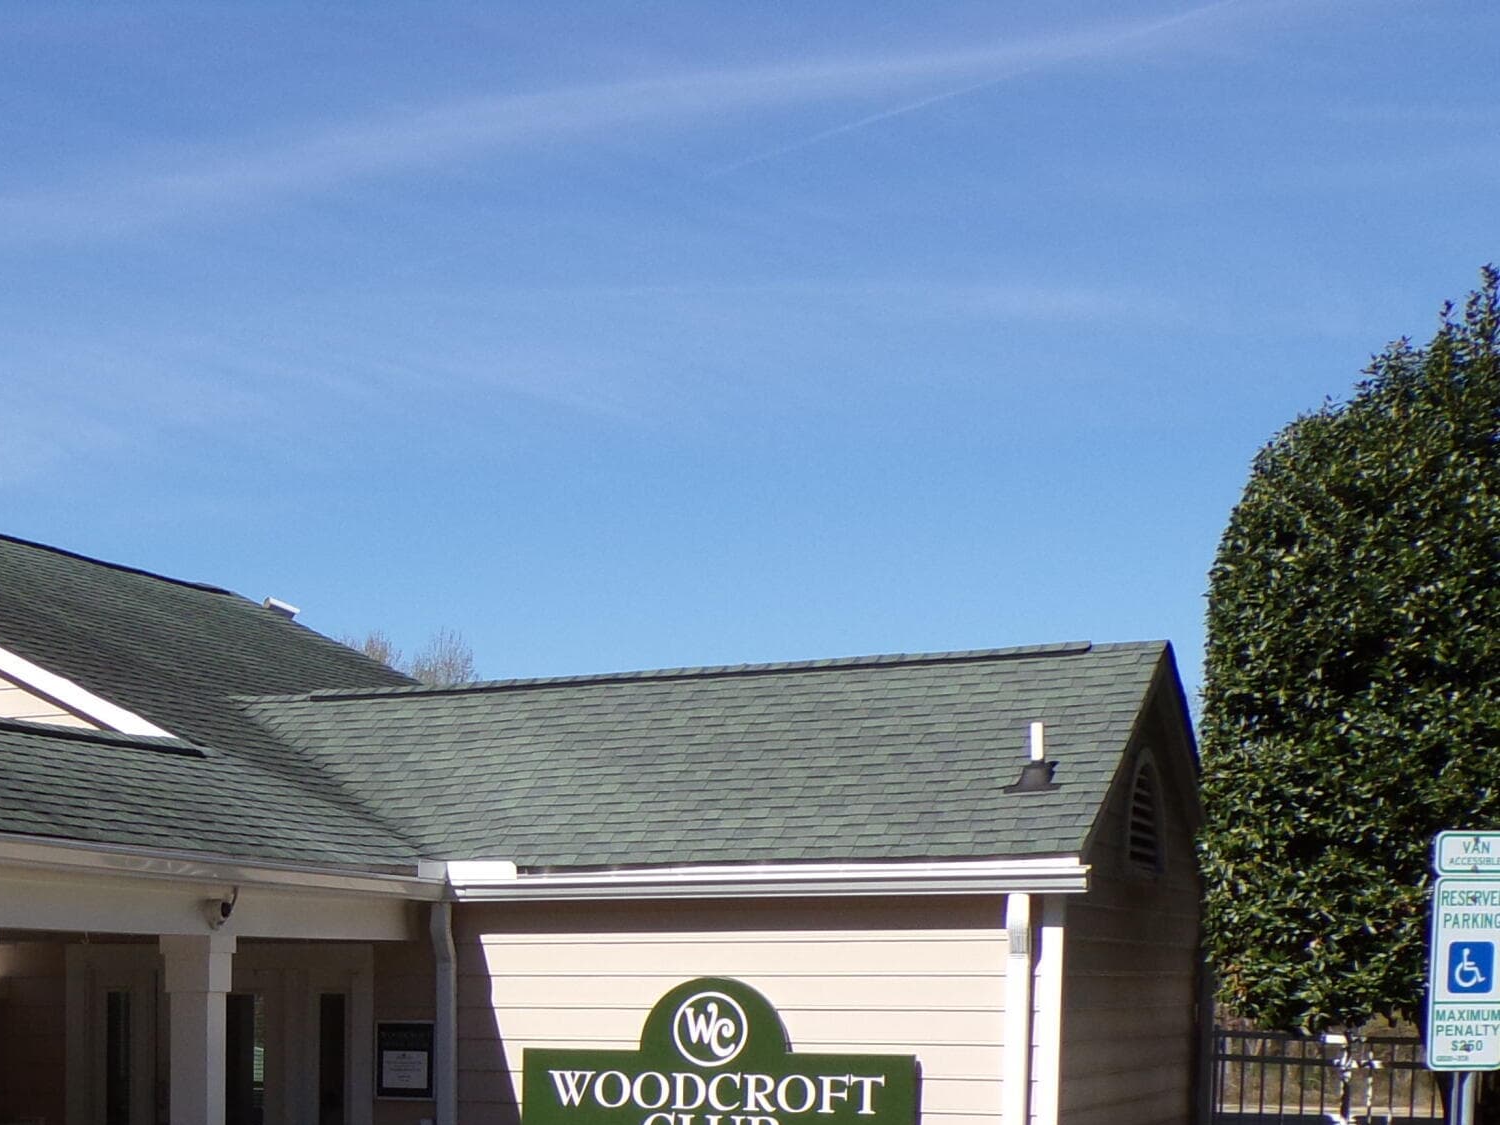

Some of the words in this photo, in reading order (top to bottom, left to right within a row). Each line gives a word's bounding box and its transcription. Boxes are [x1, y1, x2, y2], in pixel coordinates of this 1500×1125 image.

[1462, 841, 1490, 854] VAN
[1441, 890, 1500, 906] RESERVE
[1443, 913, 1500, 929] PARKING
[1435, 1009, 1500, 1021] MAXIMUM
[684, 1002, 736, 1058] WC
[1436, 1024, 1500, 1036] PENALTY
[1451, 1039, 1483, 1052] $250
[548, 1069, 885, 1115] WOODCROFT
